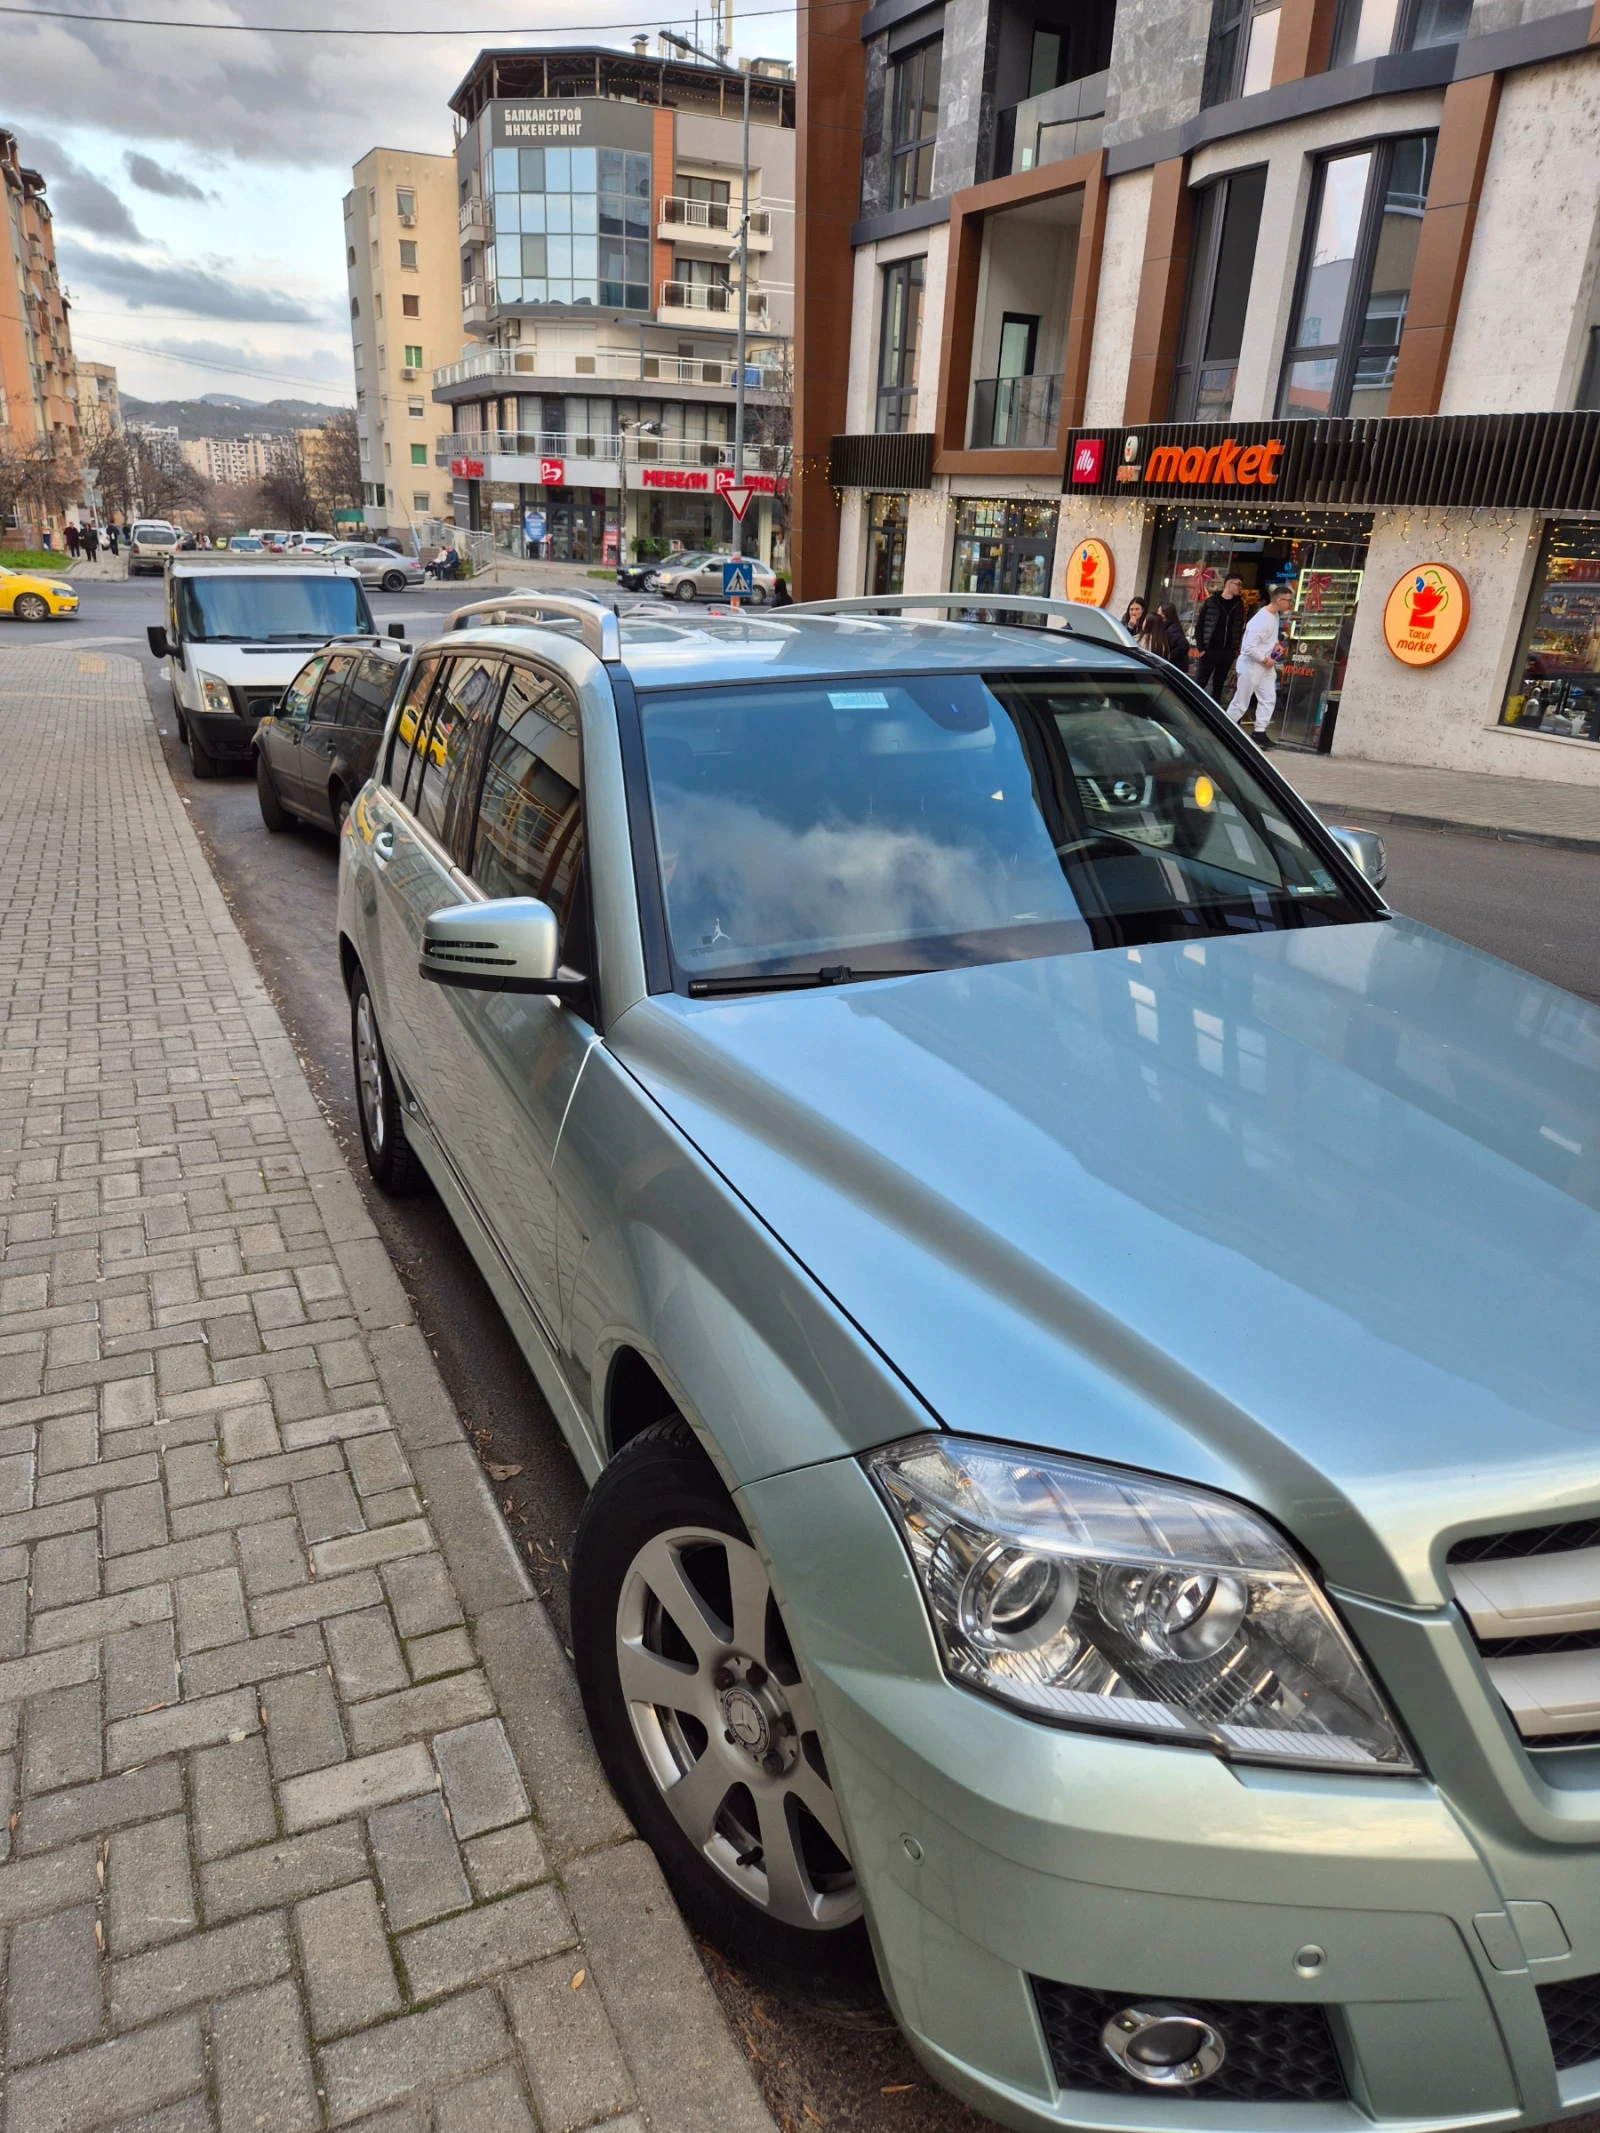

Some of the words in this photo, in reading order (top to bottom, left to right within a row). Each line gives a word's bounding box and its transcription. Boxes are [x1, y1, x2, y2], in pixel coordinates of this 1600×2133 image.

[504, 107, 582, 122] БАЛКАНСТРОЙ
[505, 123, 583, 136] ИНЖЕНЕРИНГ
[1076, 448, 1095, 476] illy
[1144, 438, 1286, 485] market
[643, 469, 708, 490] МЕБЕЛИ
[1396, 639, 1438, 654] market
[1284, 664, 1315, 677] market
